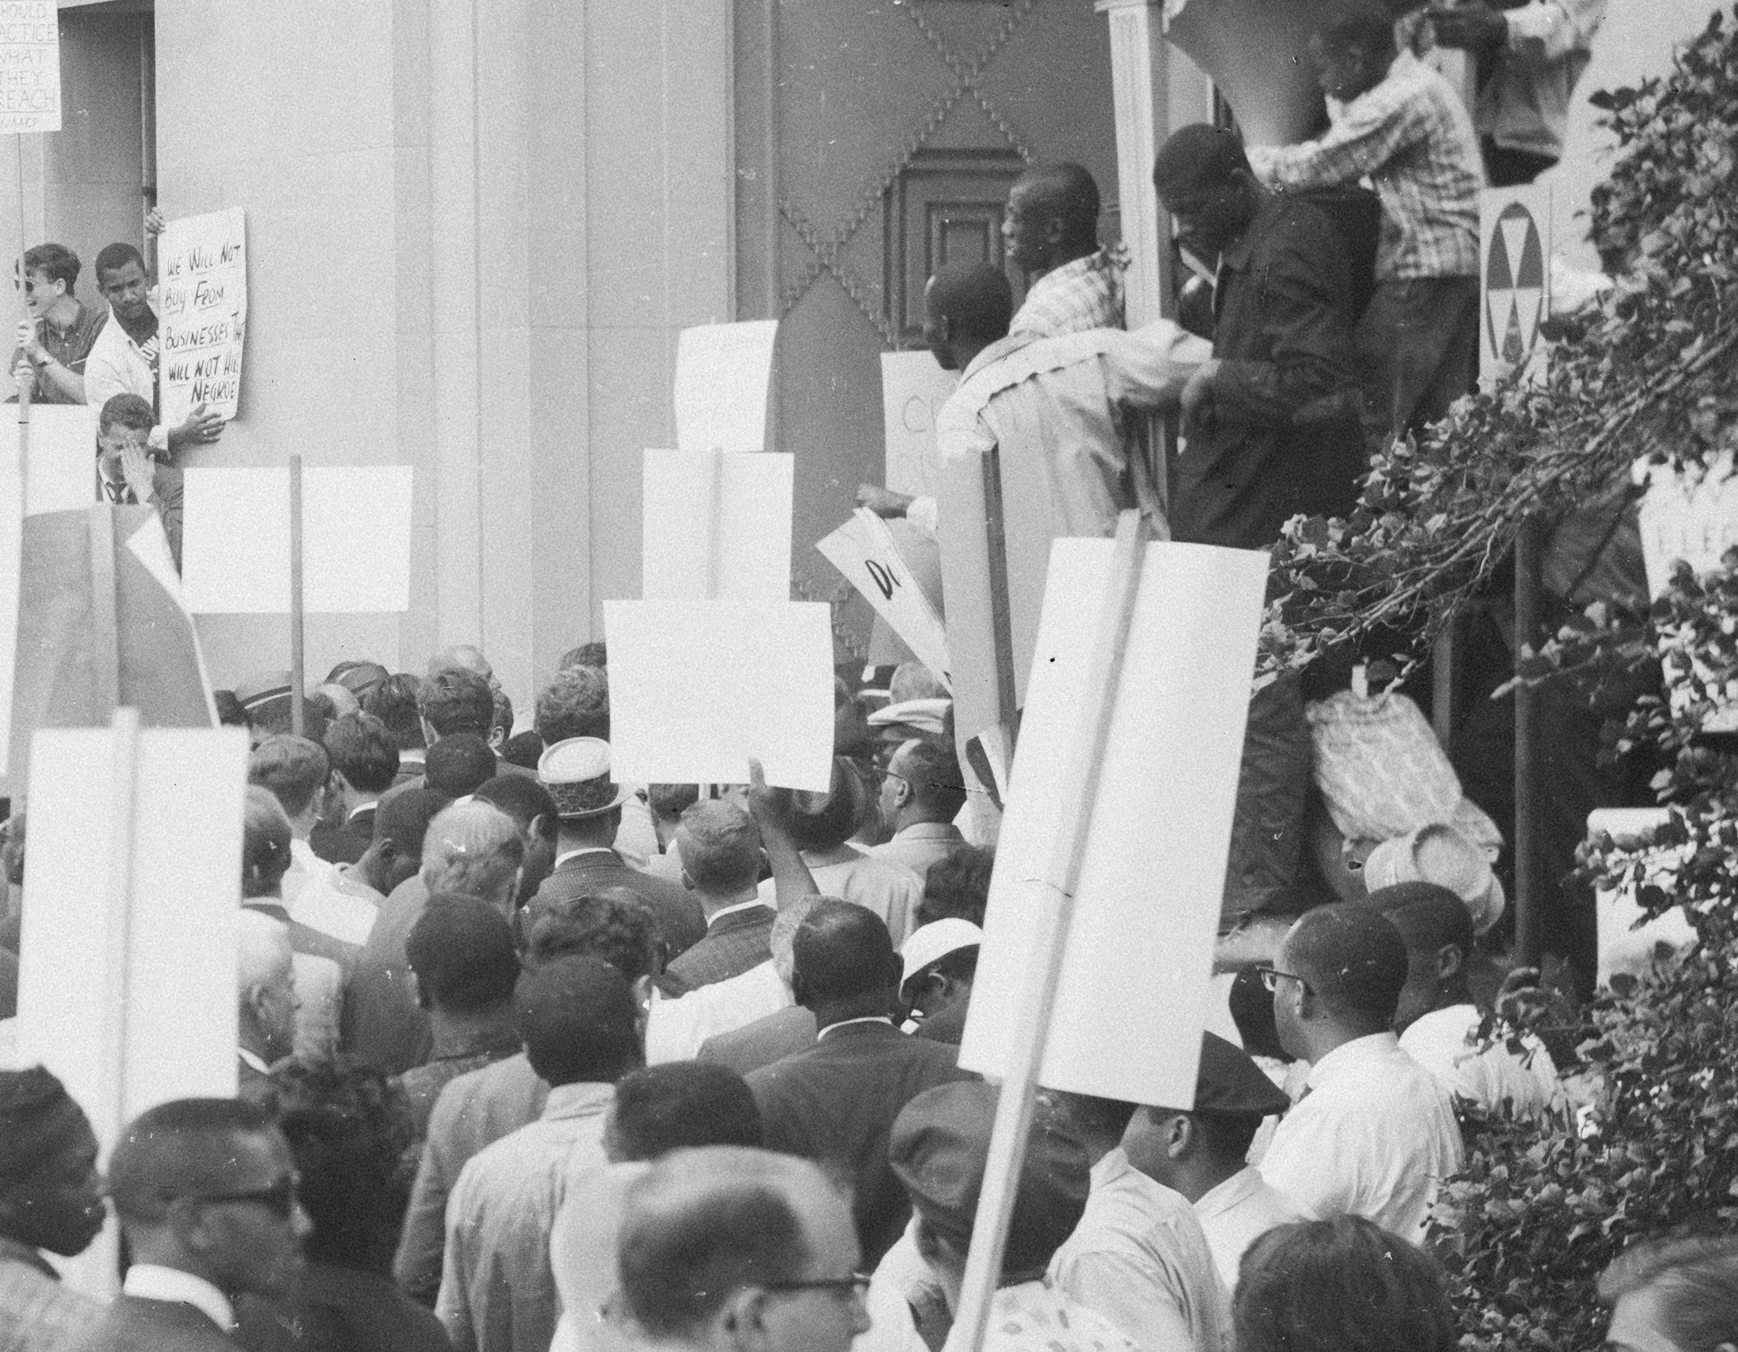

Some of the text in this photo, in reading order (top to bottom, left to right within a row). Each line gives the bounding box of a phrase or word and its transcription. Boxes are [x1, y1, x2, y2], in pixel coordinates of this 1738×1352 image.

[168, 244, 241, 276] WE WILL NOT
[194, 280, 224, 307] FROM
[165, 321, 230, 350] BUSINESSES
[169, 362, 190, 382] WILL
[194, 354, 221, 378] NOT
